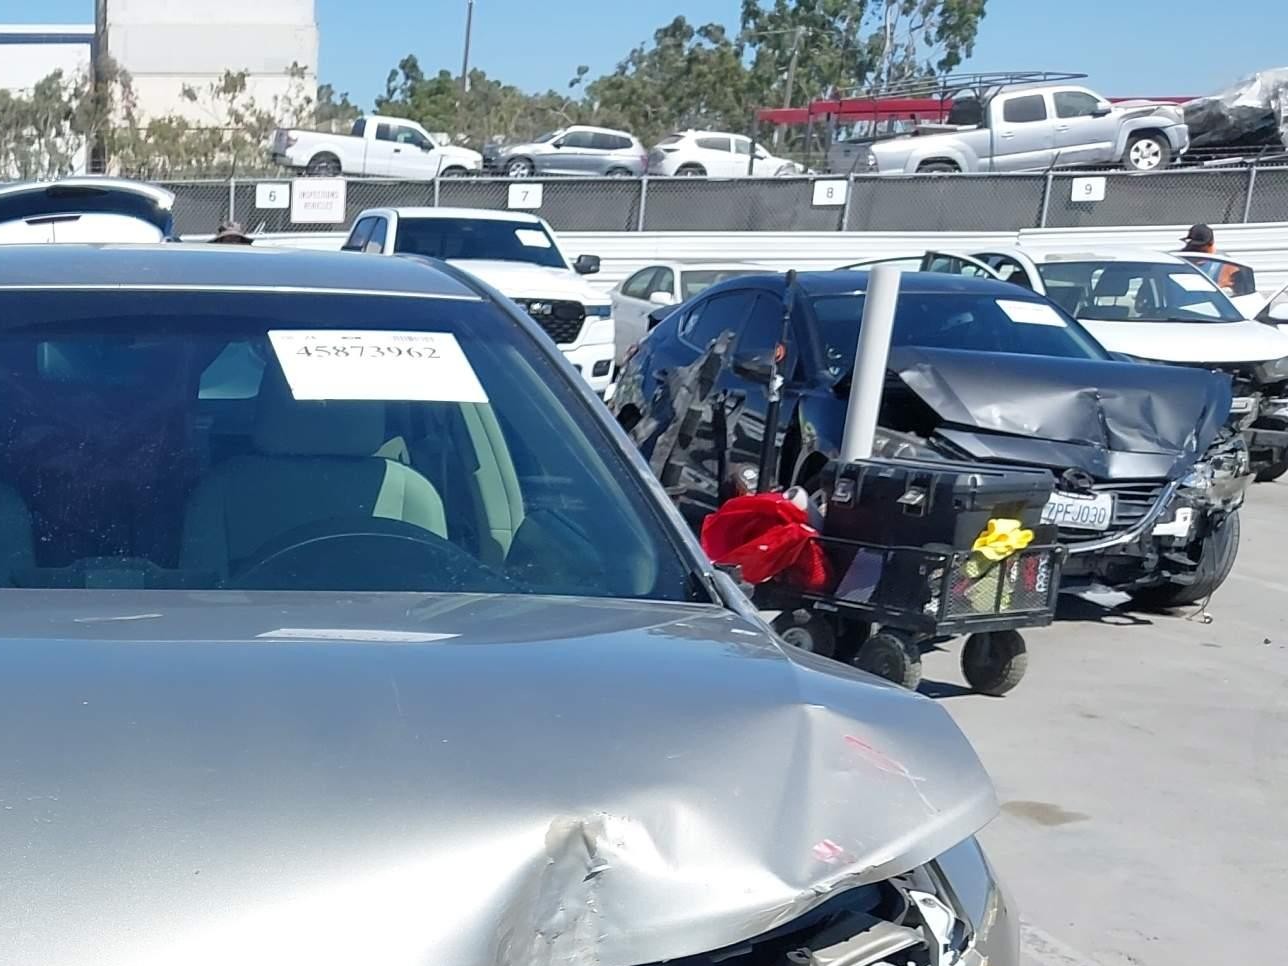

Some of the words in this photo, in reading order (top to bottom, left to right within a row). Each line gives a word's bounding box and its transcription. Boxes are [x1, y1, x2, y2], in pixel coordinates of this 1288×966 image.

[826, 187, 834, 199] 8
[1084, 183, 1092, 196] 9
[268, 191, 276, 203] 6
[520, 191, 529, 202] 7
[296, 345, 441, 359] 45873962
